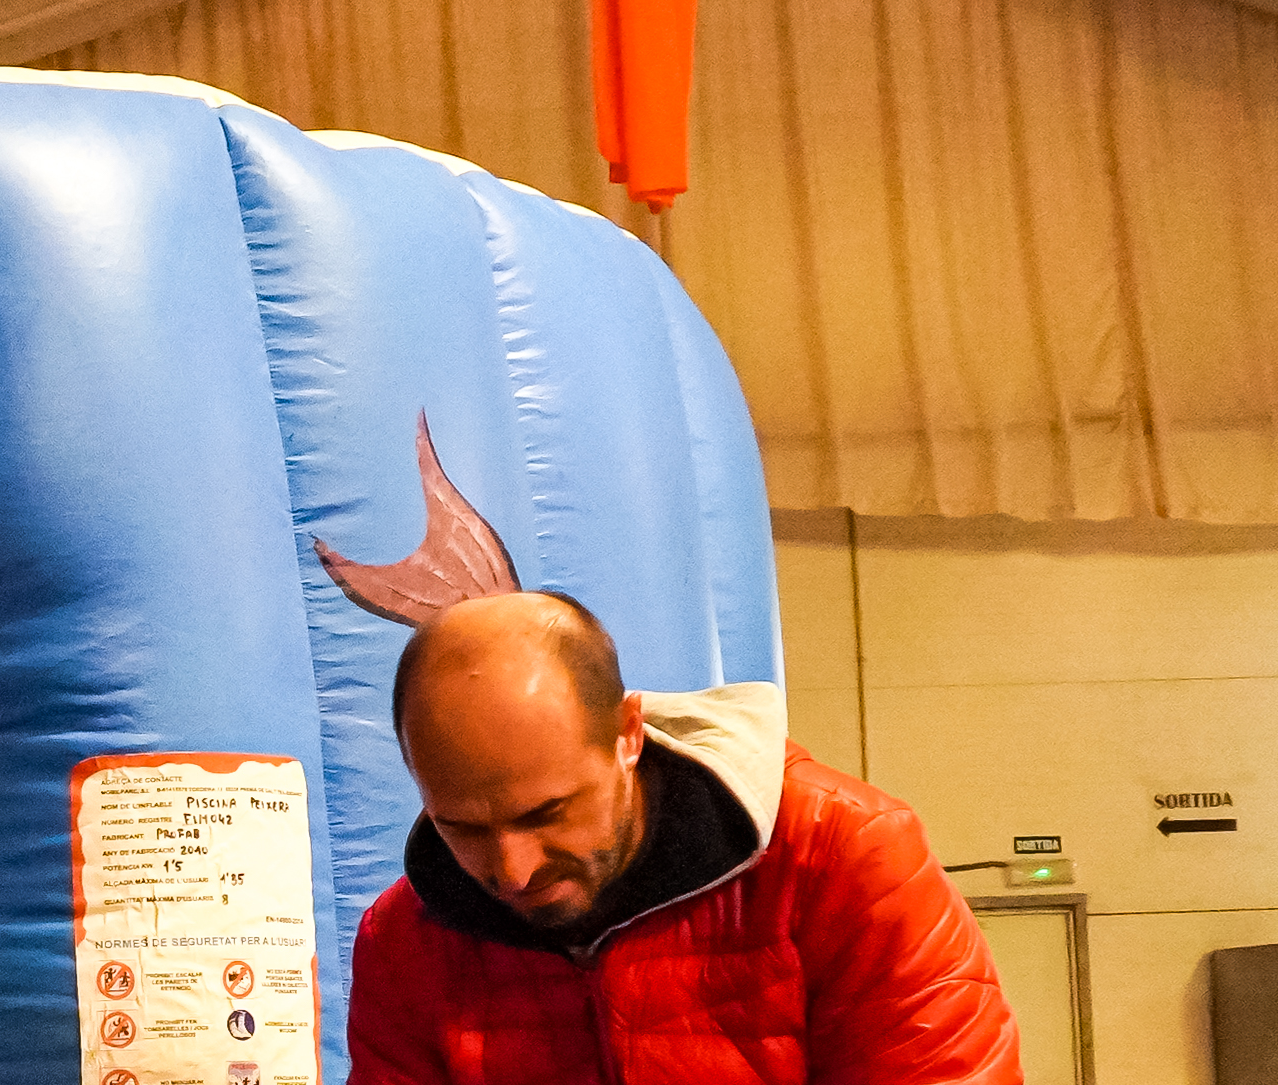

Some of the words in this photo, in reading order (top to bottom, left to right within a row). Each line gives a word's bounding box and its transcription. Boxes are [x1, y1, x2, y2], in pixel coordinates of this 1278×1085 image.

[186, 796, 237, 809] PISCINA
[1154, 791, 1233, 809] SORTIDA
[100, 803, 118, 811] NOM
[101, 833, 144, 841] FABRICANT
[221, 893, 229, 906] 8
[95, 937, 149, 950] NORMES
[152, 938, 168, 948] DE
[171, 936, 237, 948] SEGURETAT
[240, 936, 262, 946] PER
[262, 937, 270, 946] A
